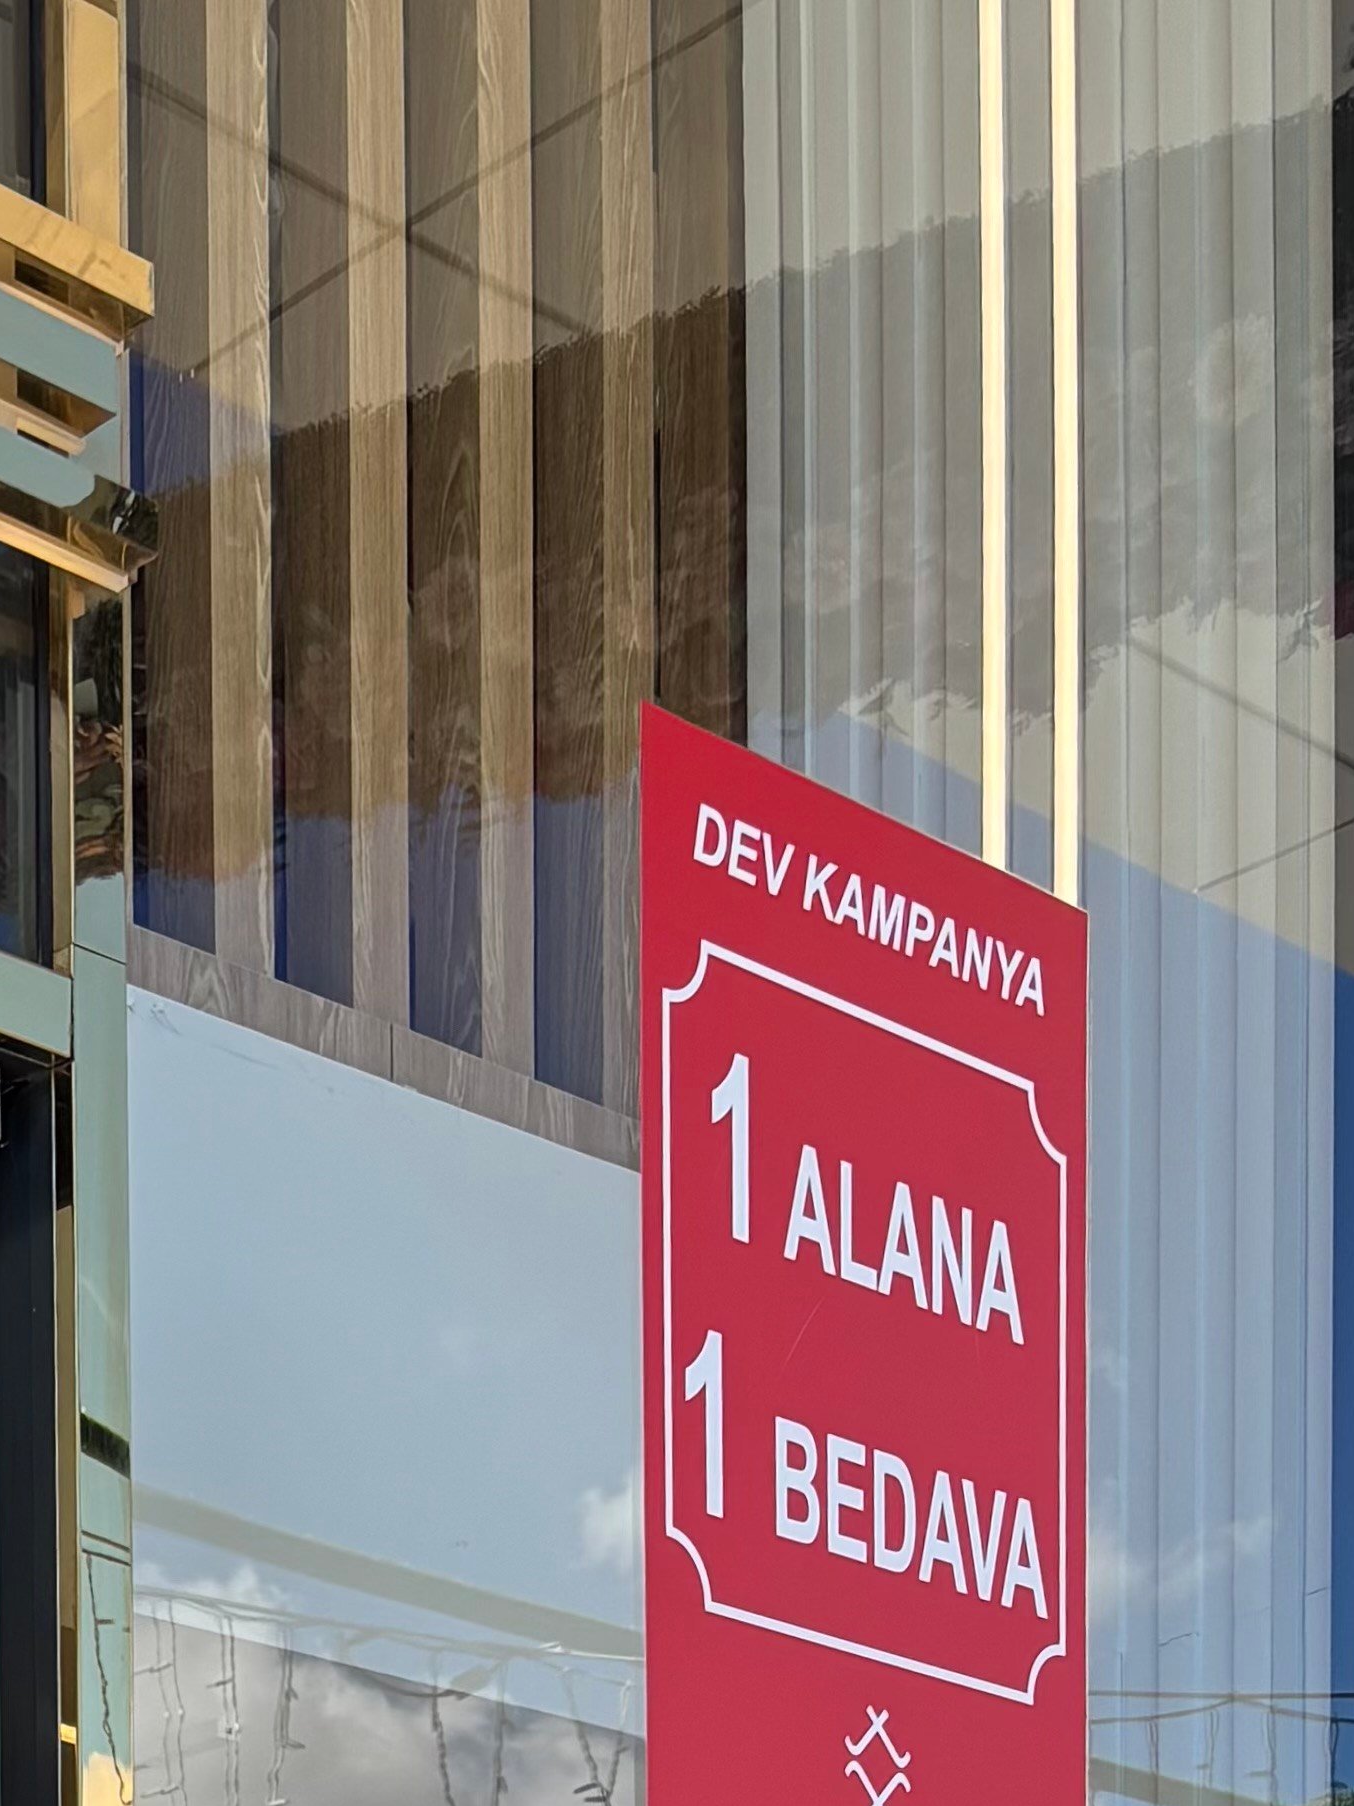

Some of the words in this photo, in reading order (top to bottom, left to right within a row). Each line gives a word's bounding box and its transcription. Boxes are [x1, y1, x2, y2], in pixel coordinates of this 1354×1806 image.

[693, 803, 796, 896] DEV
[802, 853, 1045, 1017] KAMPANYA
[711, 1052, 750, 1244] 1
[783, 1144, 1025, 1345] ALANA
[684, 1329, 724, 1519] 1
[774, 1415, 1049, 1620] BEDAVA
